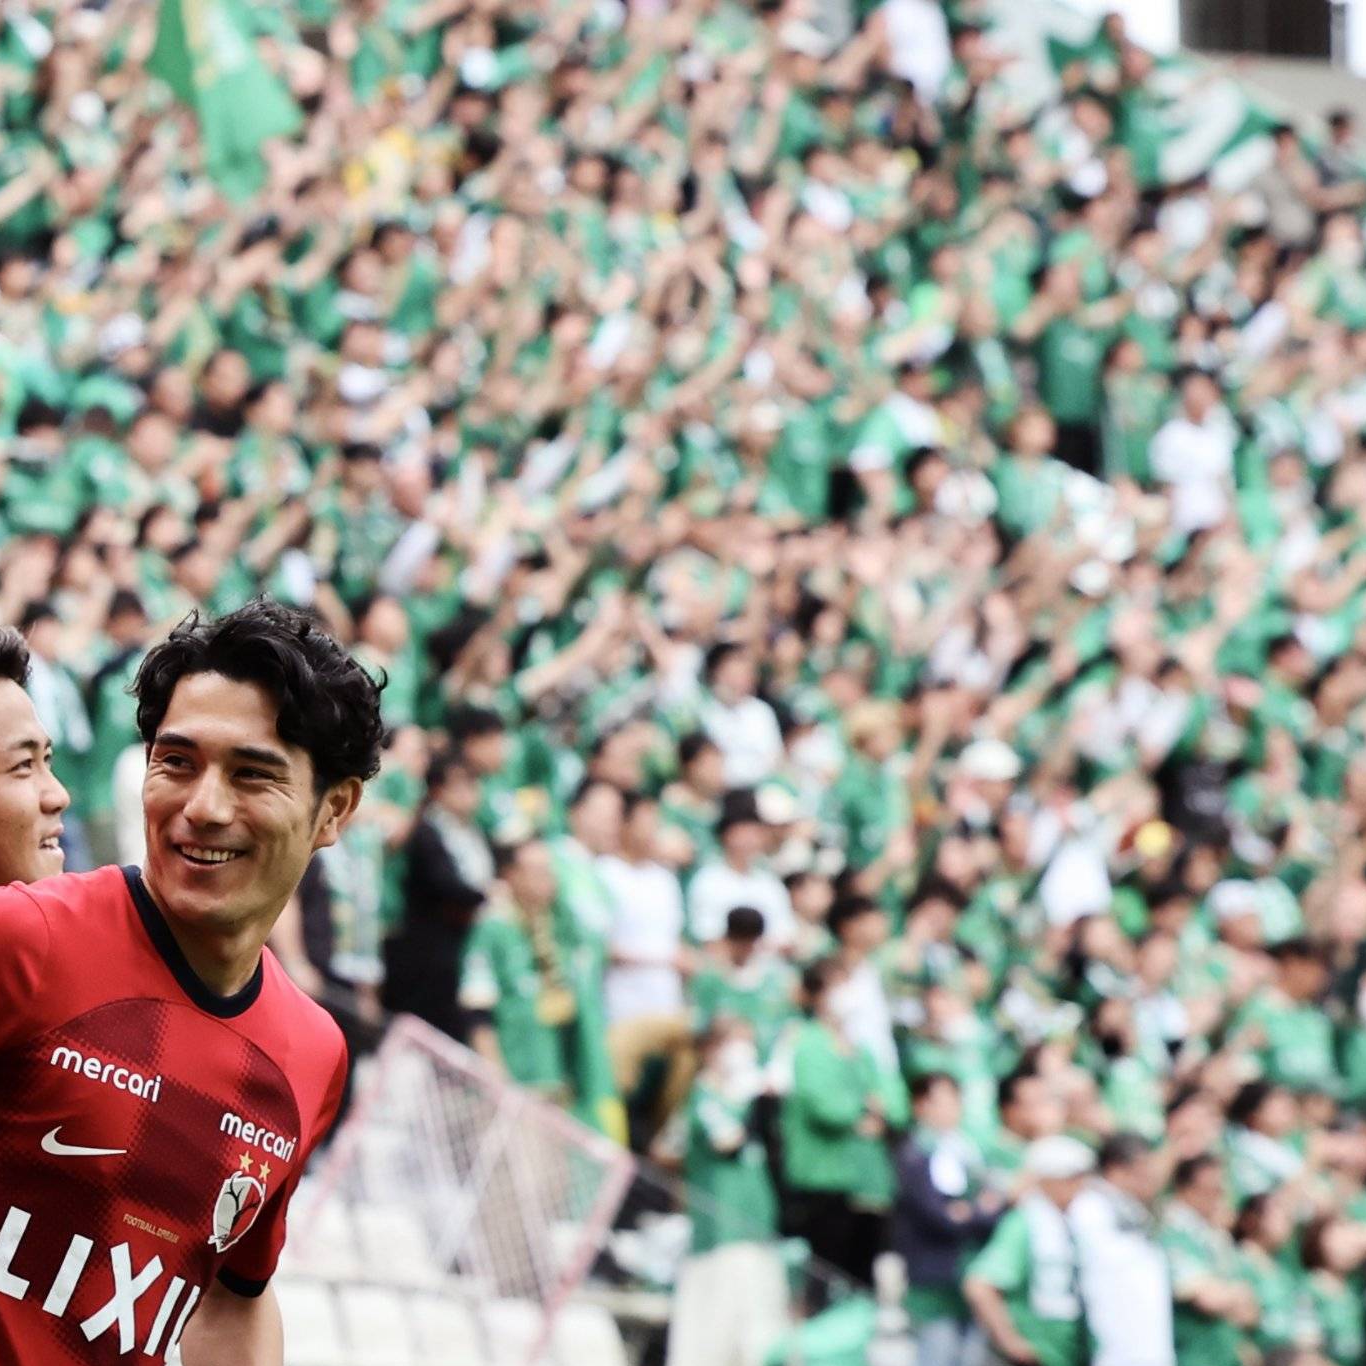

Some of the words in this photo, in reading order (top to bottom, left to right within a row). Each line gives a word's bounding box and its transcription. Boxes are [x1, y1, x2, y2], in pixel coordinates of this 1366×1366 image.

[50, 1046, 163, 1103] mercari
[219, 1112, 298, 1163] mercari
[122, 1212, 157, 1237] FOOTBALL
